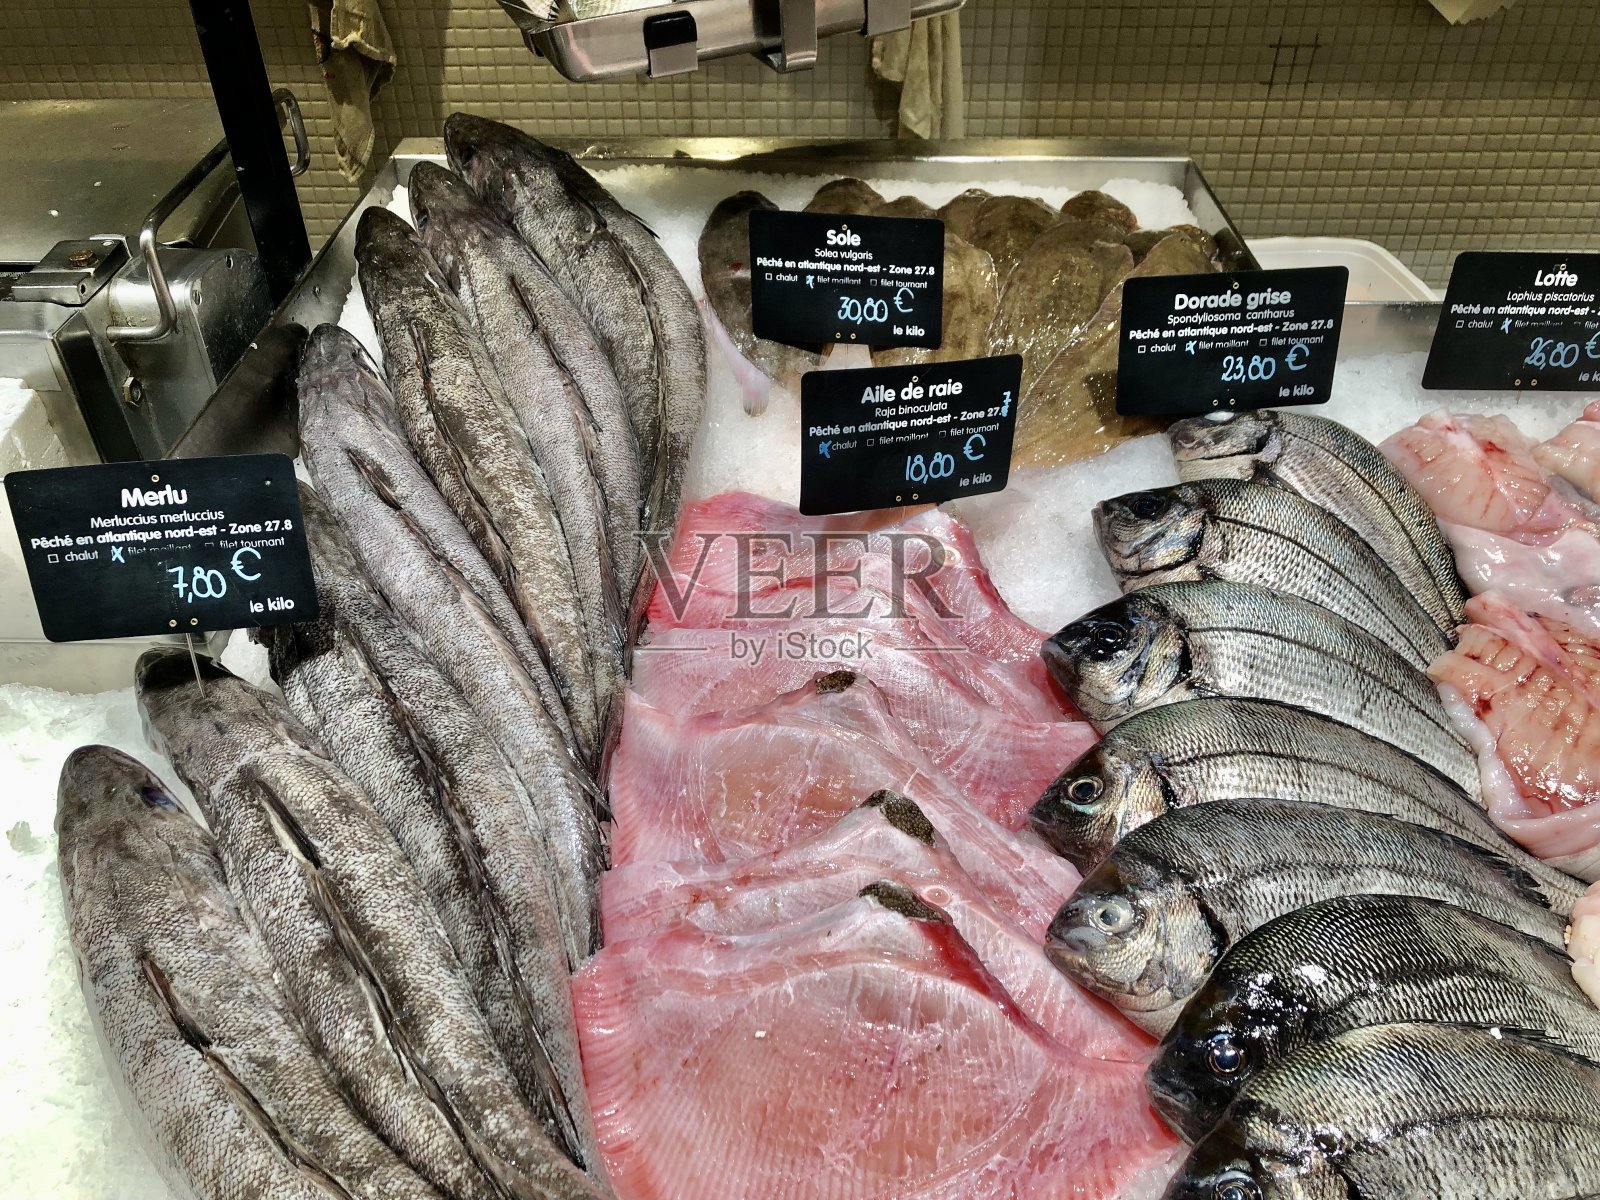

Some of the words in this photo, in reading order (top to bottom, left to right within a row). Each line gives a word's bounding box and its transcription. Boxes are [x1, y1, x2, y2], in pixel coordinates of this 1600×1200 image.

[827, 230, 861, 246] Sole
[815, 248, 838, 258] Solea
[840, 250, 873, 260] vulgaris
[757, 257, 782, 267] Pêché
[785, 260, 796, 268] en
[798, 260, 841, 272] atlantique
[844, 262, 880, 273] nord-est
[889, 265, 913, 274] Zone
[914, 266, 935, 275] 27.8
[776, 274, 798, 282] chalut
[832, 277, 861, 285] maillant
[881, 279, 894, 287] filet
[896, 280, 927, 289] tournant
[1534, 270, 1578, 286] Lotte
[1174, 289, 1242, 310] Dorade
[1247, 288, 1291, 308] grise
[1507, 291, 1542, 302] Lophius
[1544, 291, 1595, 303] piscatorius
[837, 296, 888, 325] 30,80
[1167, 312, 1241, 325] Spondyliosoma
[1246, 309, 1295, 320] cantharus
[1451, 304, 1480, 314] Pêché
[1498, 305, 1546, 316] atlantique
[1548, 306, 1589, 315] nord-est
[893, 326, 903, 335] le
[906, 326, 925, 336] kilo
[1130, 329, 1160, 340] Pêché
[1162, 330, 1175, 338] en
[1178, 326, 1228, 337] atlantique
[1230, 324, 1273, 334] nord-est
[1282, 322, 1308, 332] Zone
[1311, 319, 1334, 330] 27.8
[1468, 320, 1493, 328] chalut
[1585, 321, 1599, 329] filet
[1151, 343, 1176, 353] chalut
[1199, 341, 1214, 350] filet
[1216, 339, 1249, 348] maillant
[1272, 337, 1286, 346] filet
[1288, 335, 1324, 345] tournant
[1221, 355, 1276, 383] 23,80
[1579, 371, 1589, 381] le
[861, 385, 895, 404] Aile
[900, 382, 924, 401] de
[928, 379, 963, 398] raie
[1279, 387, 1290, 397] le
[1293, 385, 1314, 396] kilo
[875, 407, 896, 418] Raja
[898, 401, 948, 415] binoculata
[809, 424, 841, 437] Pêché
[843, 425, 856, 434] en
[858, 420, 908, 433] atlantique
[910, 414, 952, 427] nord-est
[960, 410, 985, 421] Zone
[832, 440, 857, 450] chalut
[879, 436, 894, 445] filet
[950, 427, 964, 437] filet
[966, 423, 999, 435] tournant
[960, 477, 970, 487] le
[972, 473, 992, 485] kilo
[121, 484, 188, 508] Merlu
[90, 514, 157, 529] Merluccius
[160, 508, 225, 524] merluccius
[31, 534, 73, 550] Pêché
[76, 535, 94, 546] en
[97, 528, 162, 544] atlantique
[165, 525, 217, 538] nord-est
[229, 522, 262, 535] Zone
[265, 519, 293, 532] 27.8
[65, 550, 99, 562] chalut
[219, 539, 238, 550] filet
[240, 536, 285, 548] tournant
[167, 565, 227, 603] 7,80
[250, 599, 264, 613] le
[267, 596, 295, 611] kilo
